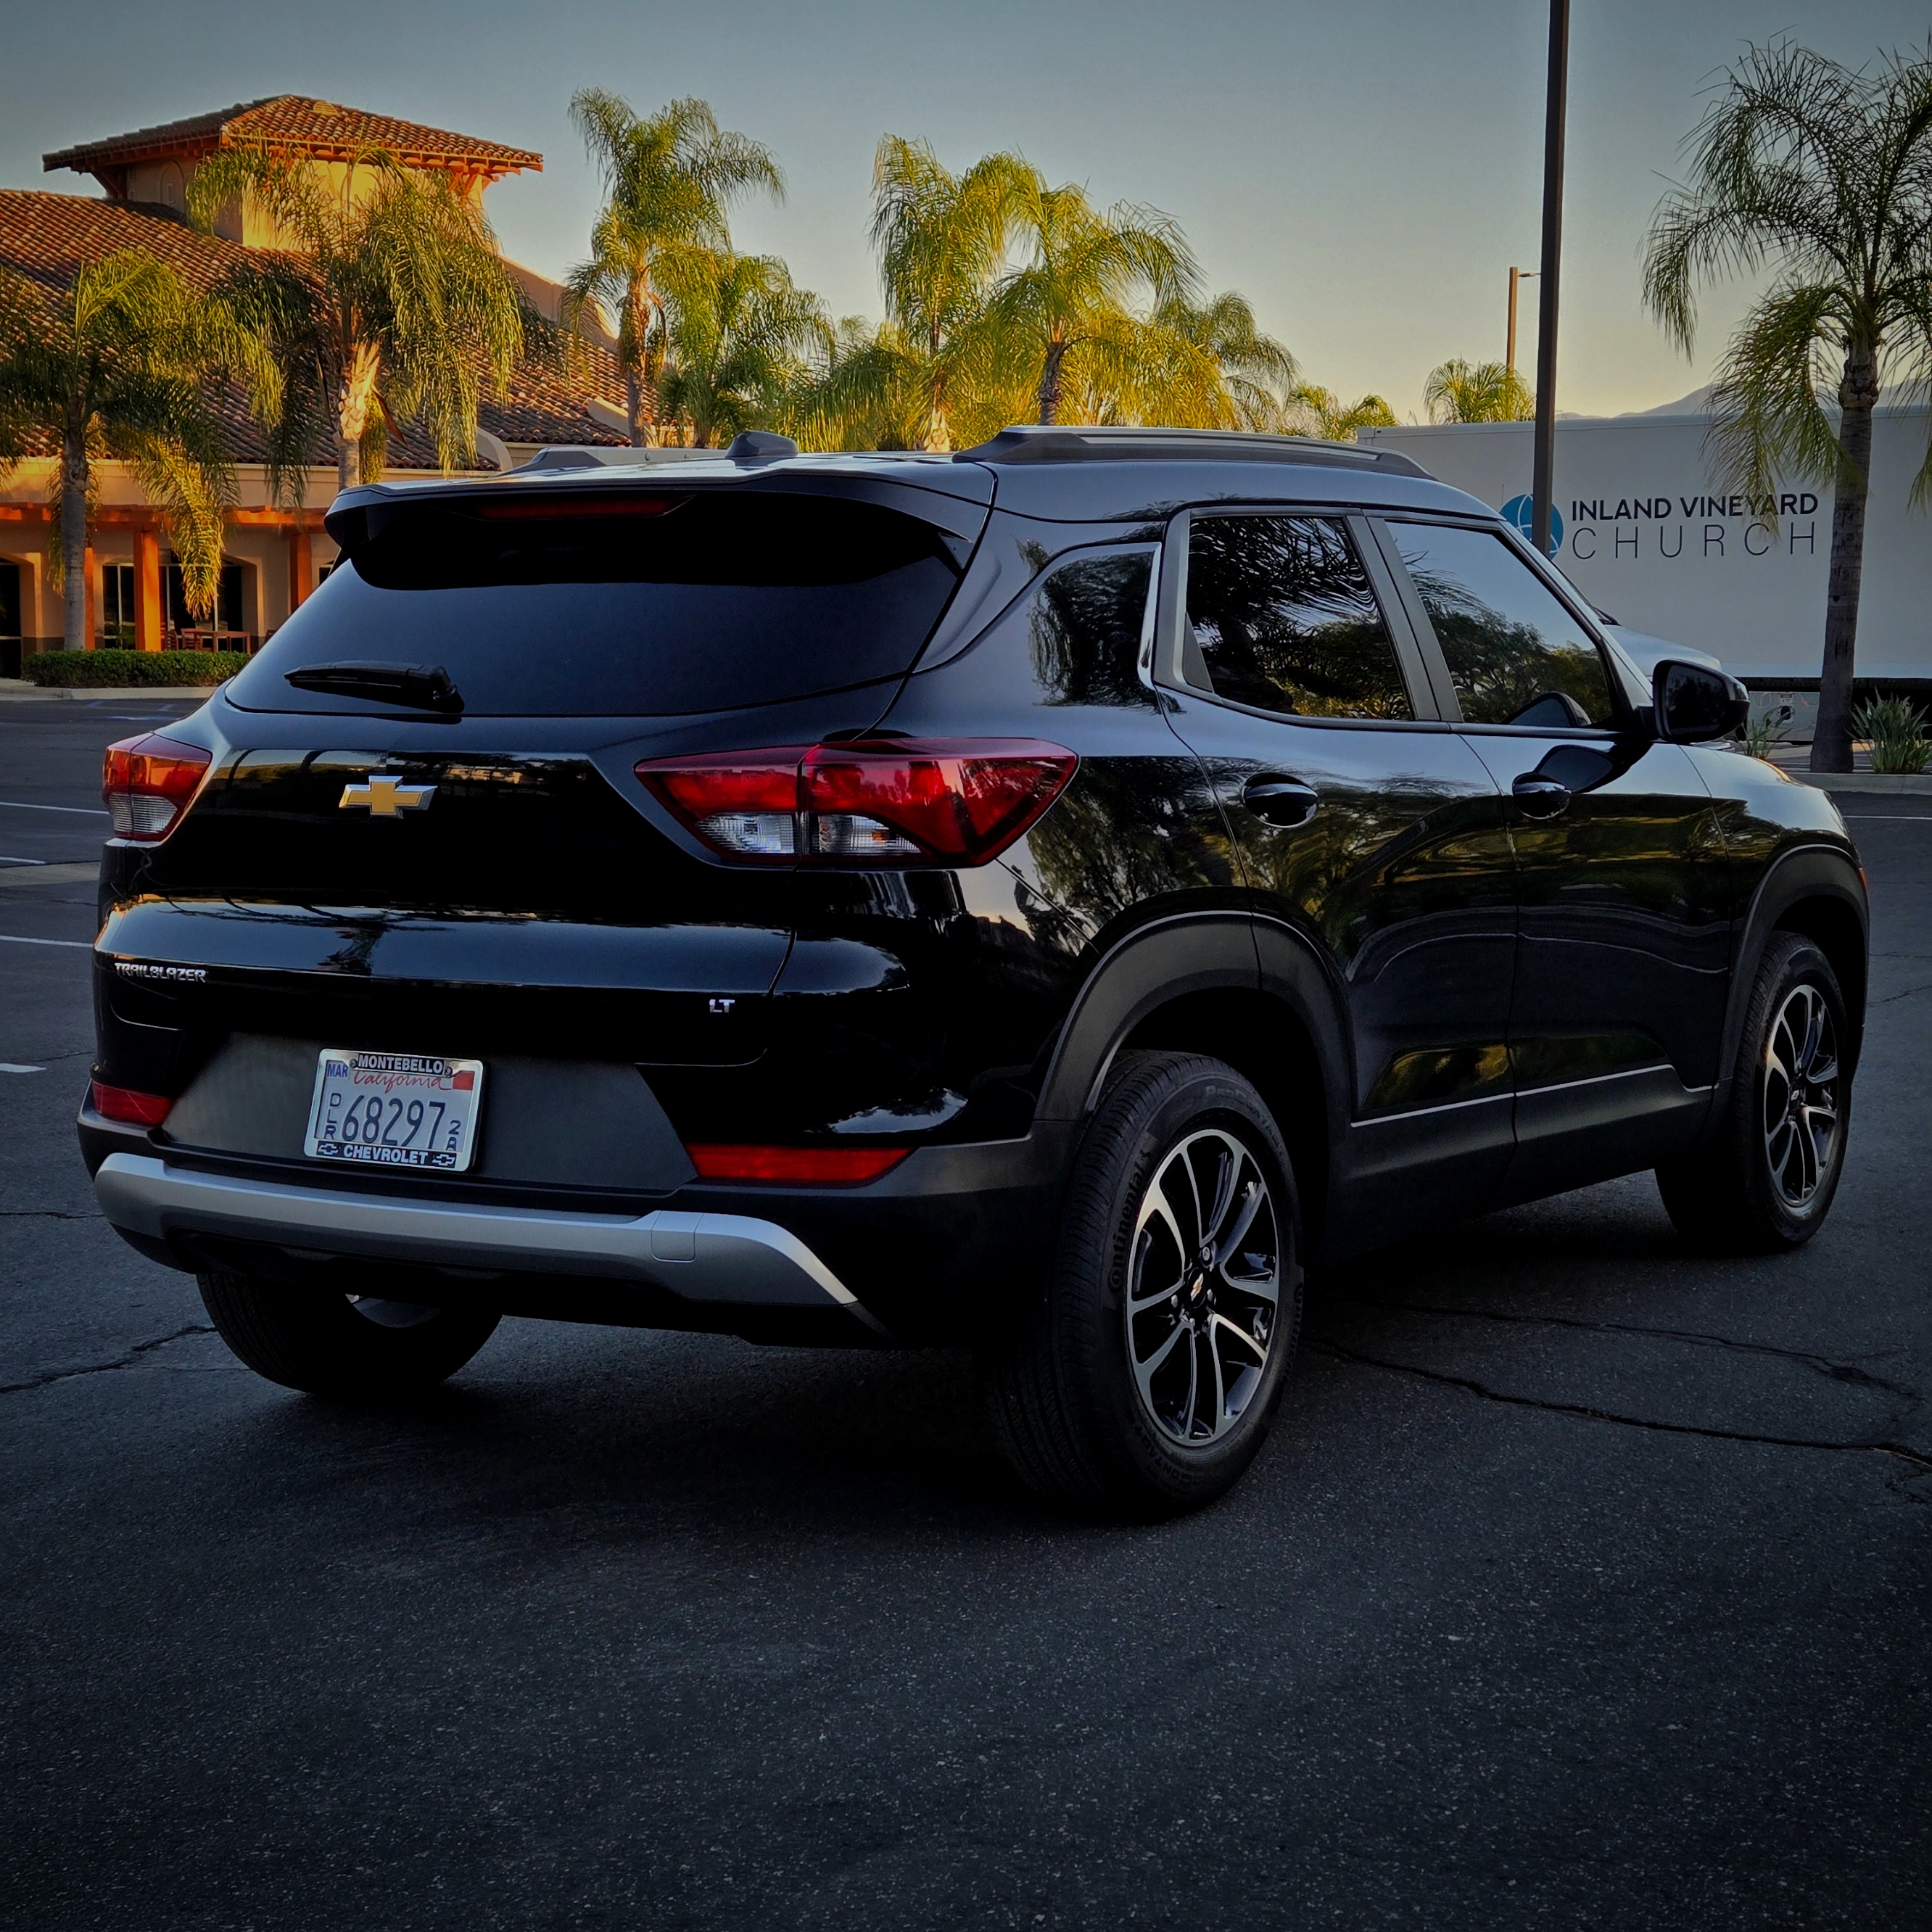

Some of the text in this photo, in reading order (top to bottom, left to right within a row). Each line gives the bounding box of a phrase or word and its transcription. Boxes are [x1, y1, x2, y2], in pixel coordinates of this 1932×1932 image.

[1572, 498, 1672, 521] INLAND
[1572, 521, 1815, 559] CHURCH
[115, 962, 206, 983] TRAILBLAZER
[709, 999, 735, 1013] LT
[327, 1064, 349, 1078] MAR
[358, 1054, 443, 1073] MONTEBELLO
[342, 1095, 446, 1149] 68297
[343, 1144, 428, 1165] CHEVROLET
